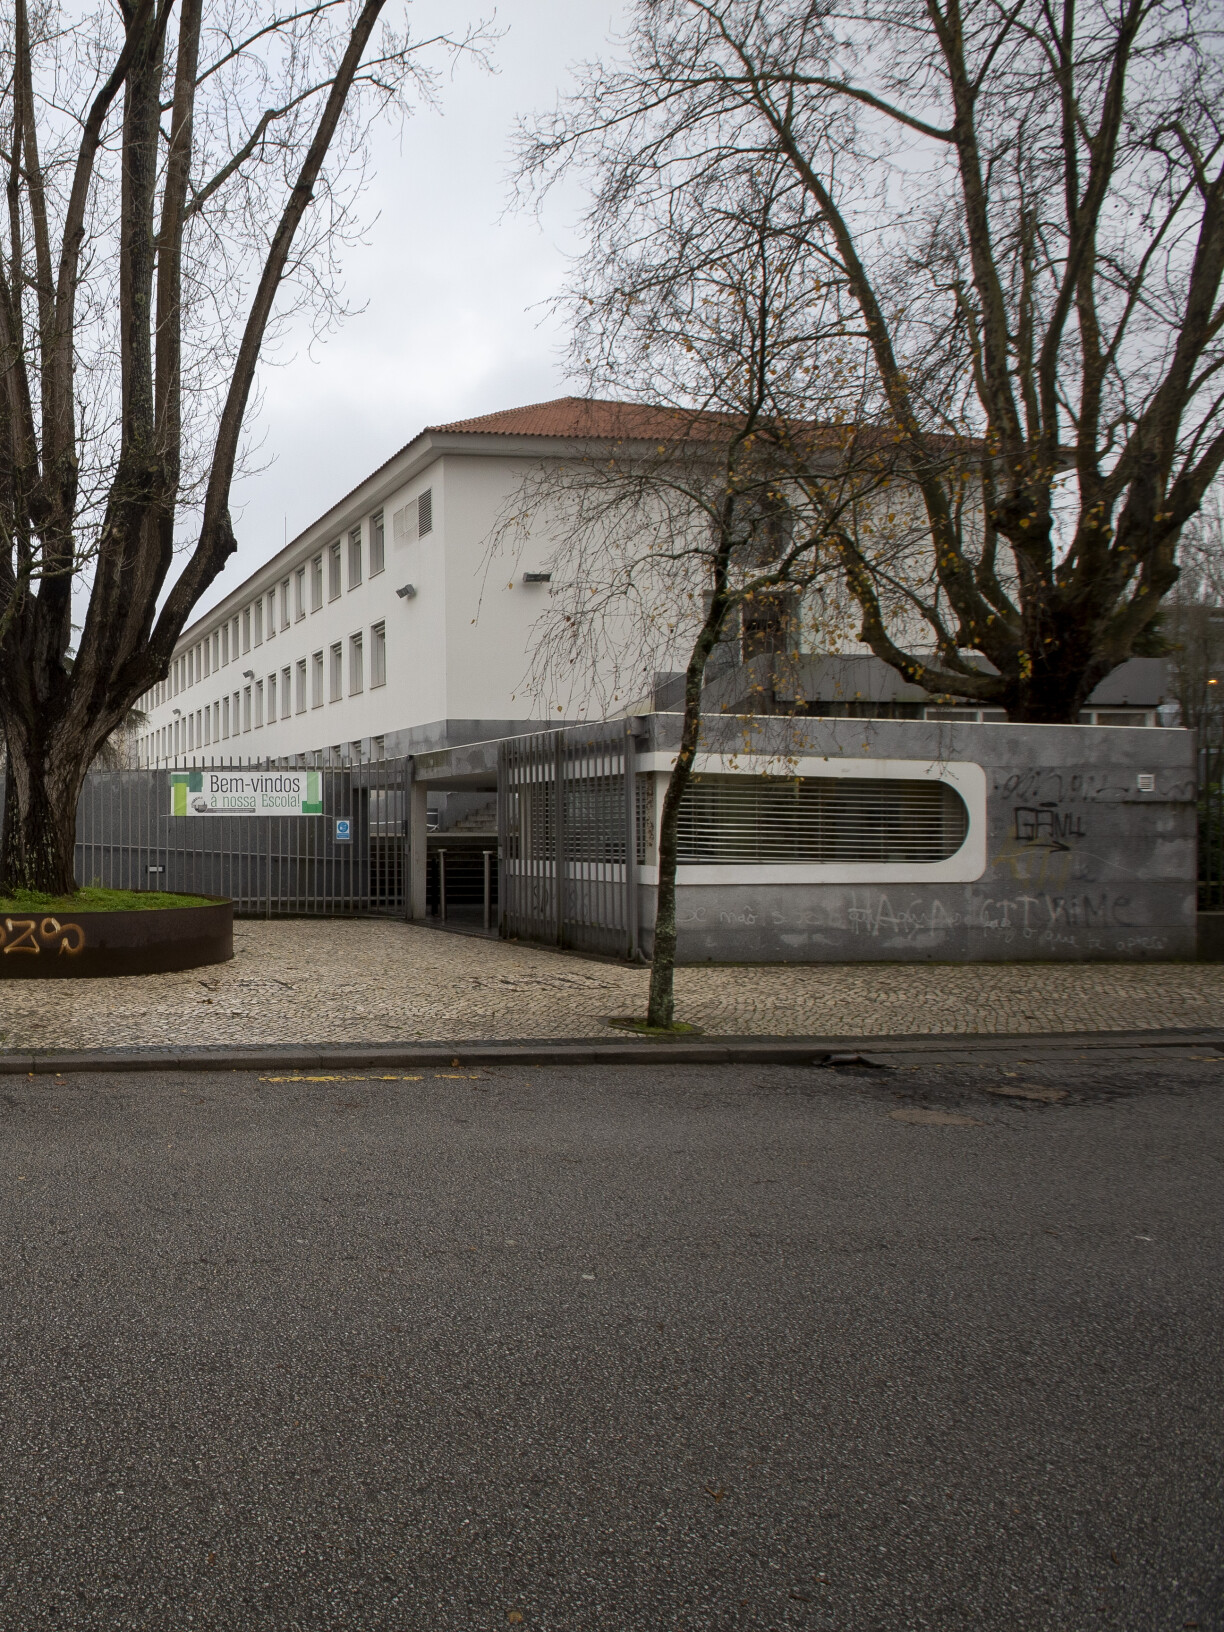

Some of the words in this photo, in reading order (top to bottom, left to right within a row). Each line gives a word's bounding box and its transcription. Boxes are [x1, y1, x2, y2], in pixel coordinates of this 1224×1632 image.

[210, 774, 301, 793] Bem-vindos
[210, 794, 218, 808] à
[222, 795, 257, 808] nossa
[261, 793, 301, 808] Escola!
